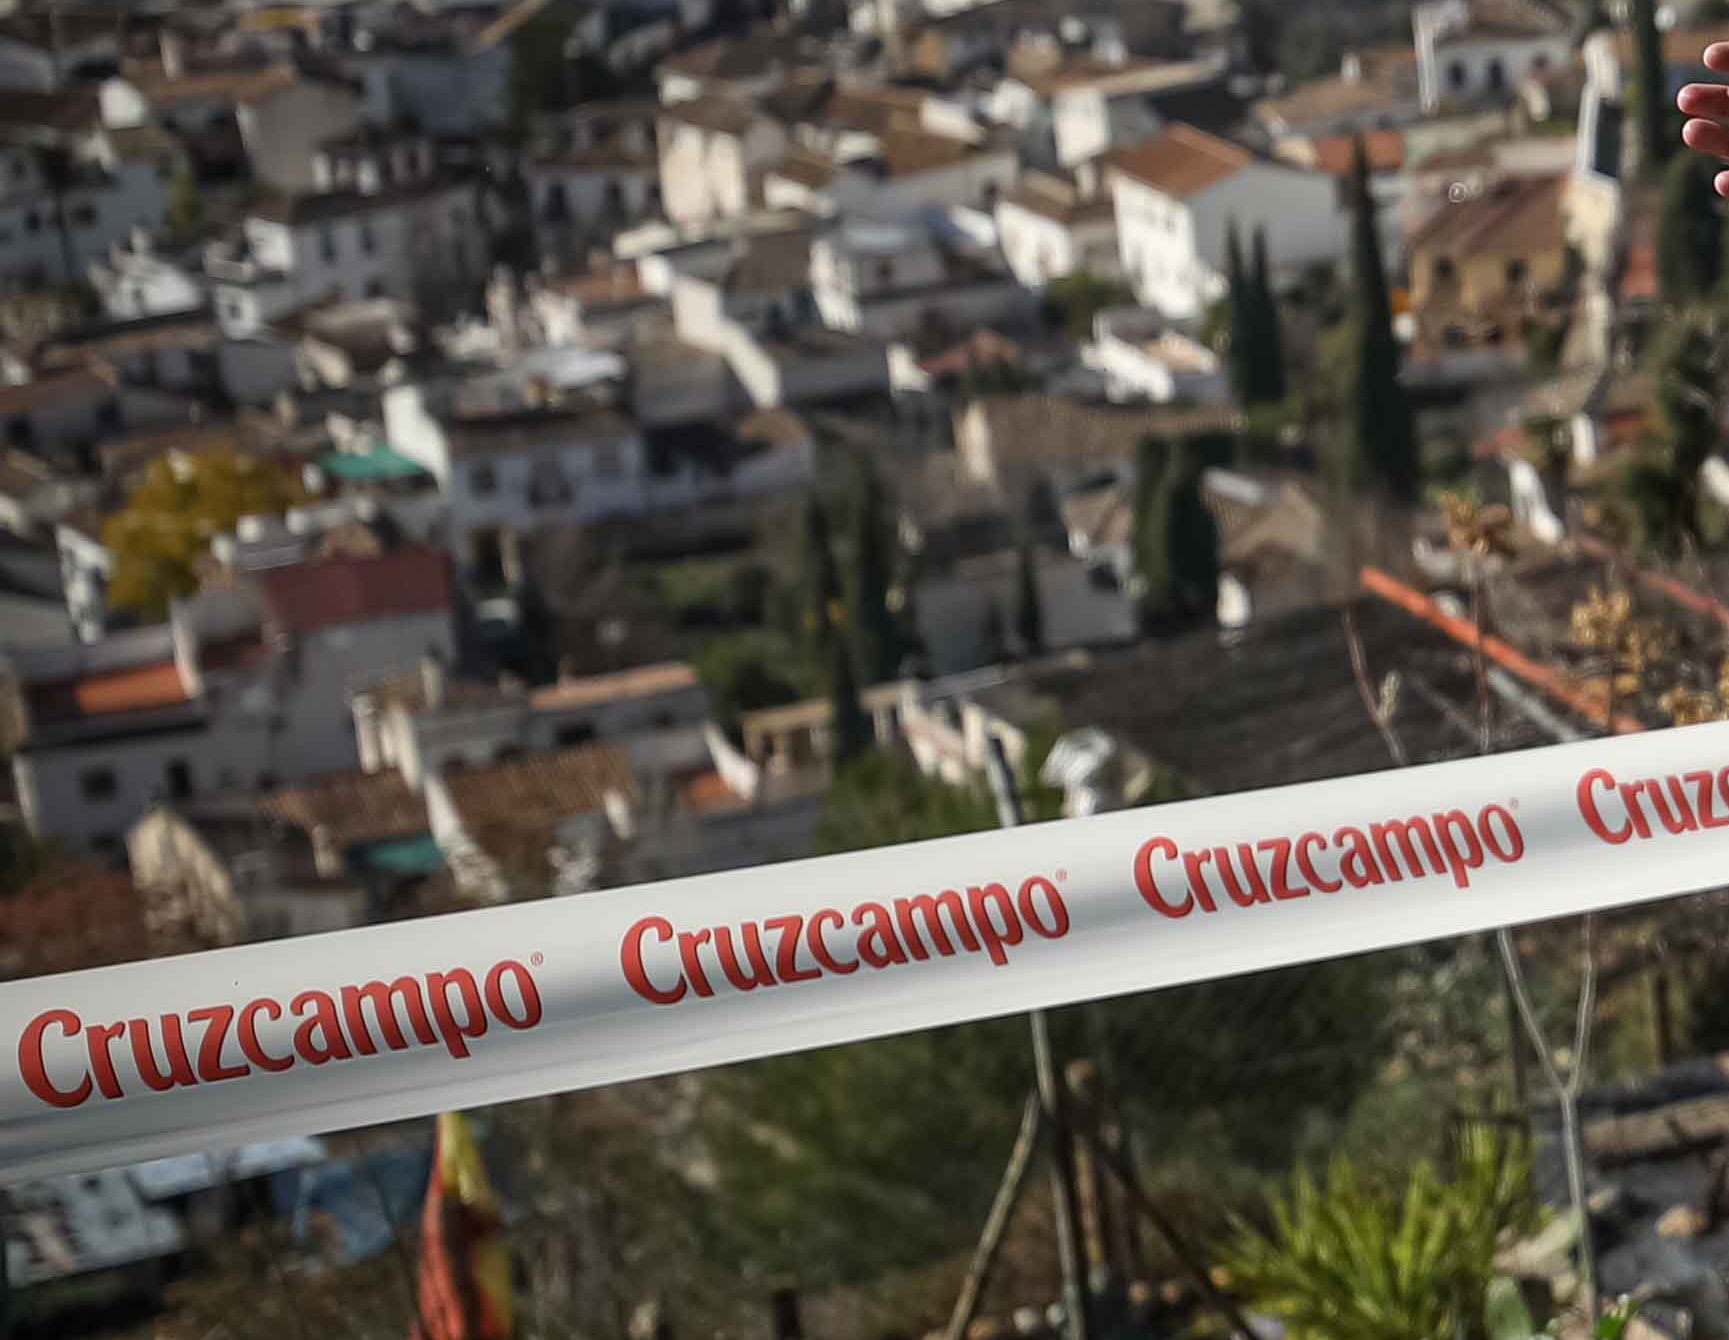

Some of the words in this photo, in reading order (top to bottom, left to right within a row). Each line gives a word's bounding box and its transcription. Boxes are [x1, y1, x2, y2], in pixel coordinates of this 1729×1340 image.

[18, 958, 544, 1111] Cruzcampo
[619, 873, 1070, 1006] Cruzcampo
[1133, 803, 1524, 920] Cruzcampo
